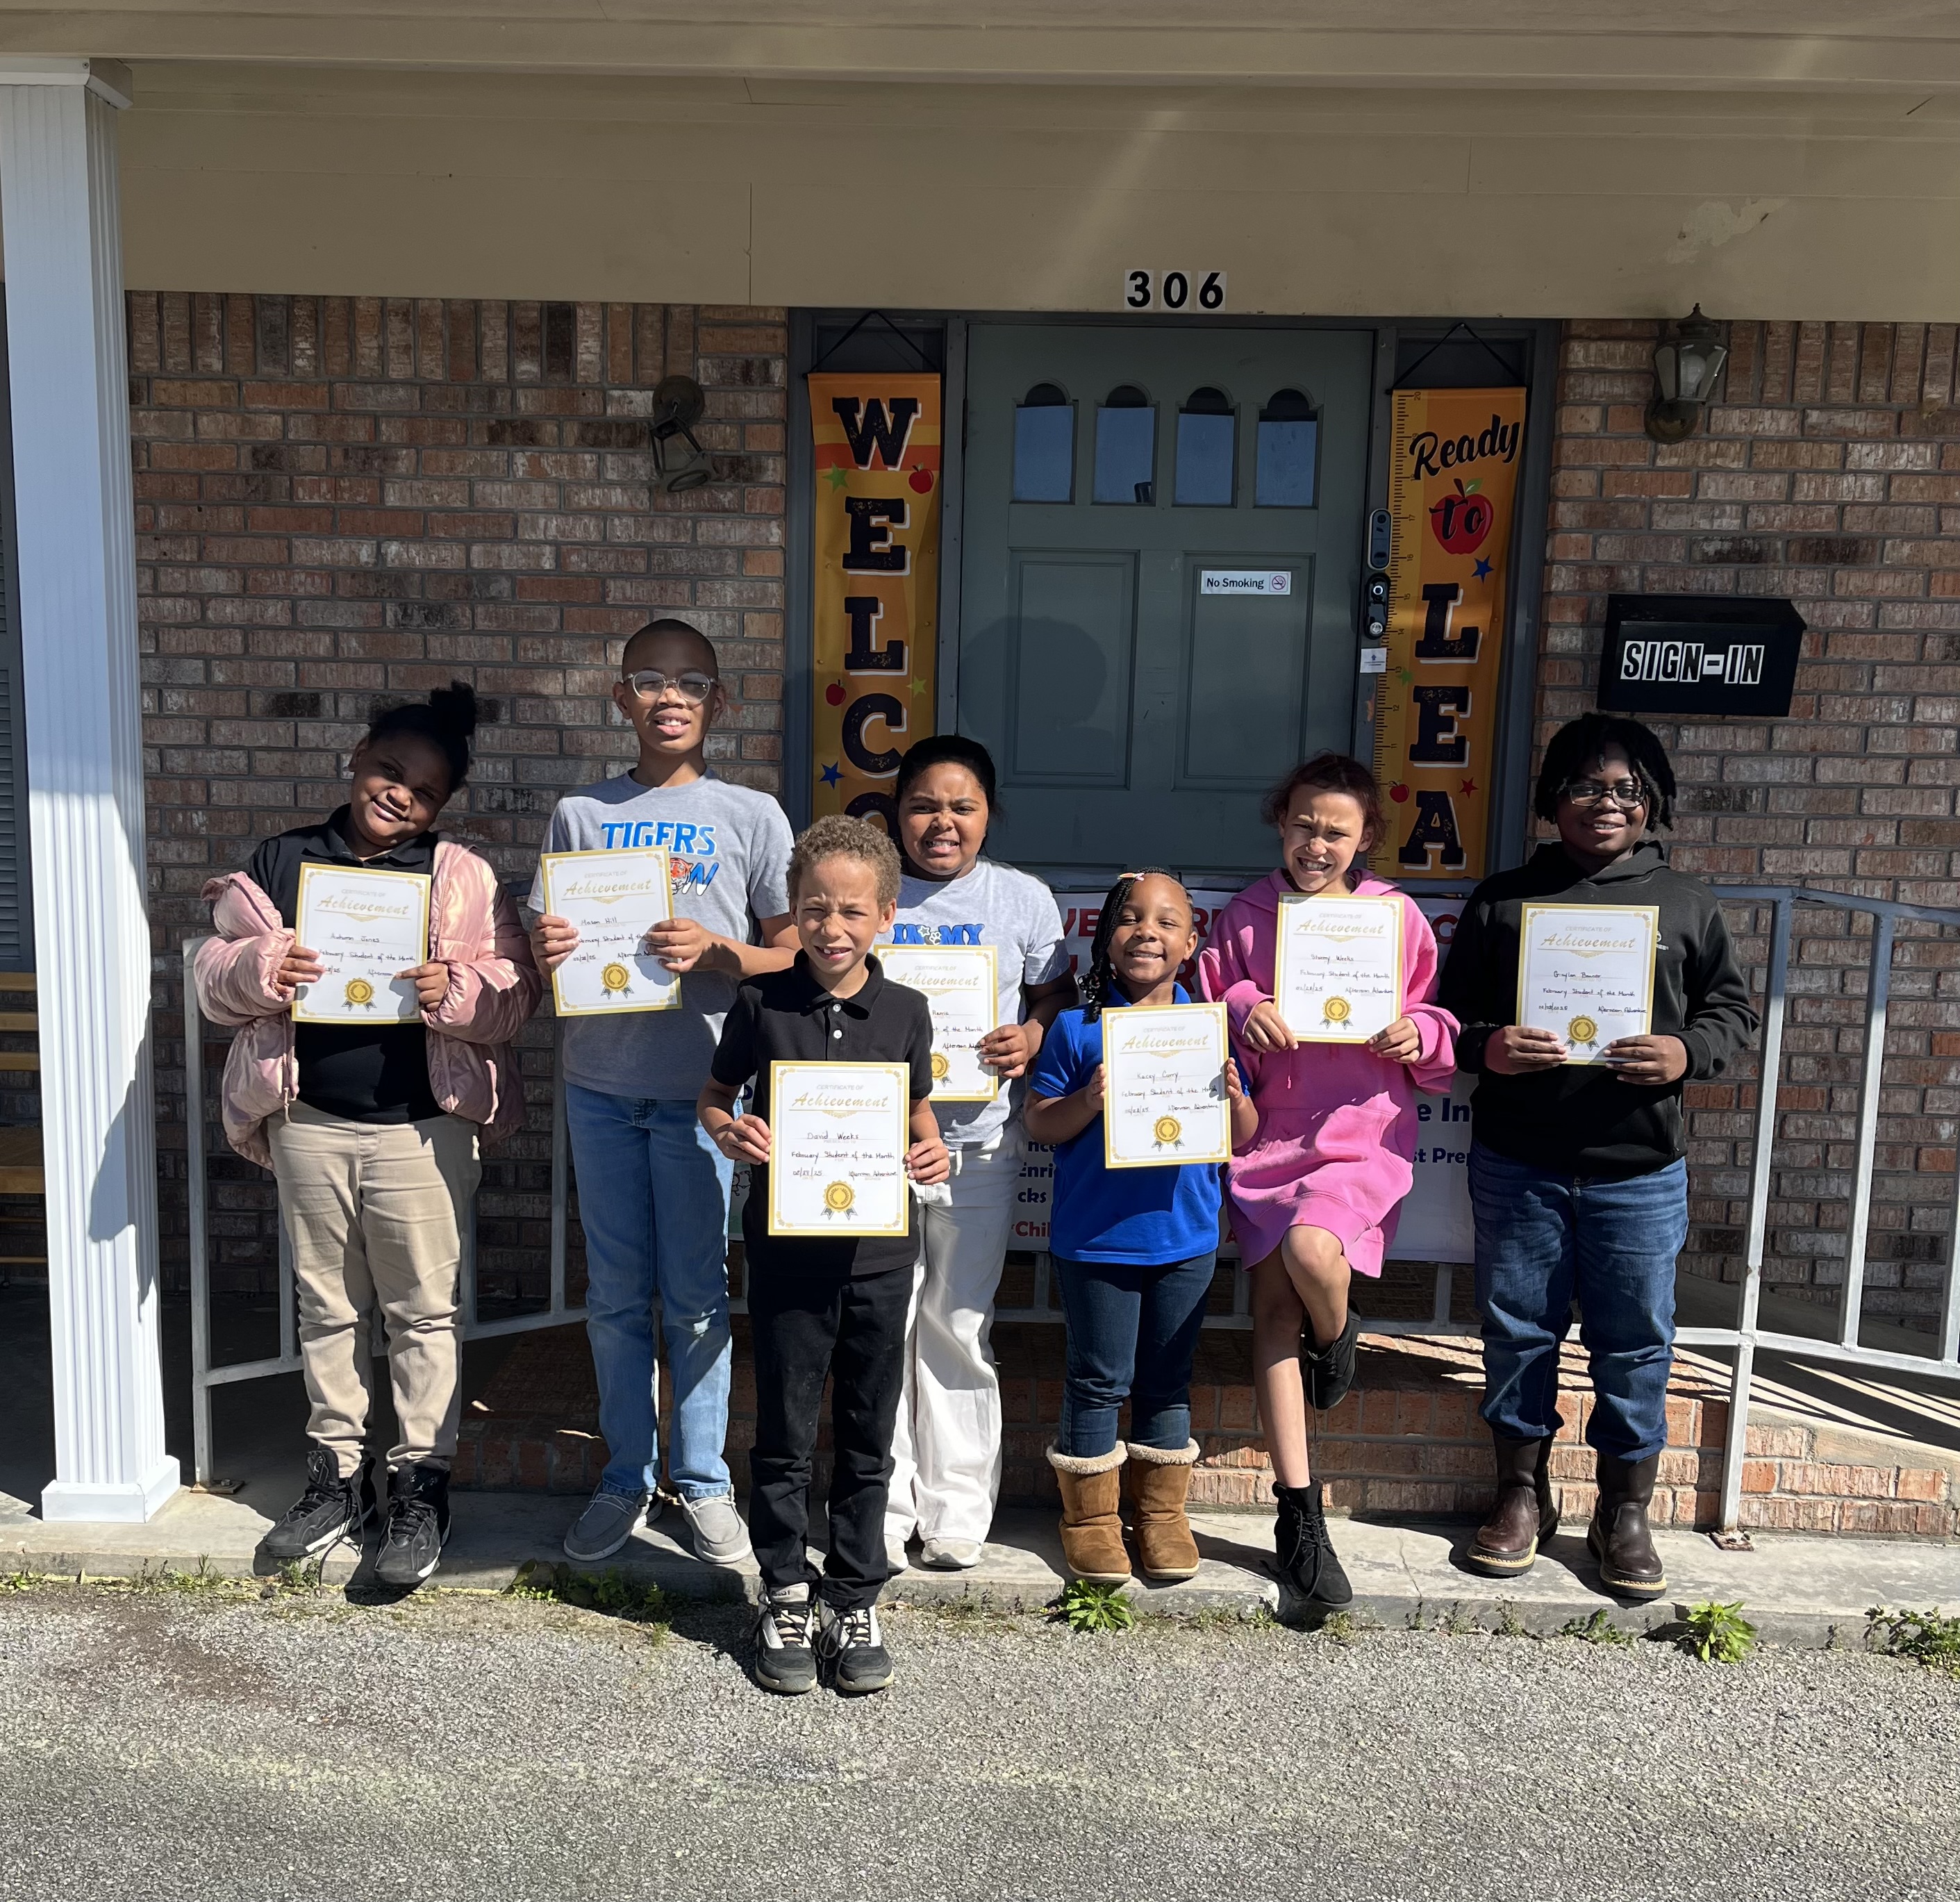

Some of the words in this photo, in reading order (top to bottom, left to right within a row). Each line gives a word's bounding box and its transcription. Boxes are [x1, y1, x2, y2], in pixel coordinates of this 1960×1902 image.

[1127, 271, 1223, 308] 306
[1409, 413, 1520, 481] Ready
[1429, 497, 1485, 540] to
[1206, 578, 1220, 588] No
[1222, 578, 1264, 590] Smoking
[1622, 642, 1763, 684] SIGN-IN
[601, 820, 717, 857] TIGERS
[563, 879, 652, 896] Achievement
[317, 895, 409, 915] Achievement
[1296, 919, 1384, 934] Achievement
[629, 934, 633, 943] of
[938, 924, 985, 945] MY
[1540, 933, 1636, 948] Achievement
[377, 953, 384, 963] of
[895, 973, 979, 986] Achievement
[1352, 970, 1359, 981] of
[1597, 989, 1603, 998] of
[1122, 1034, 1209, 1050] Achievement
[1137, 1073, 1155, 1084] Kacey
[1177, 1087, 1183, 1096] of
[792, 1092, 888, 1107] Achievement
[807, 1130, 829, 1140] David
[837, 1132, 859, 1140] Weeks
[791, 1151, 820, 1164] February
[852, 1151, 858, 1161] of
